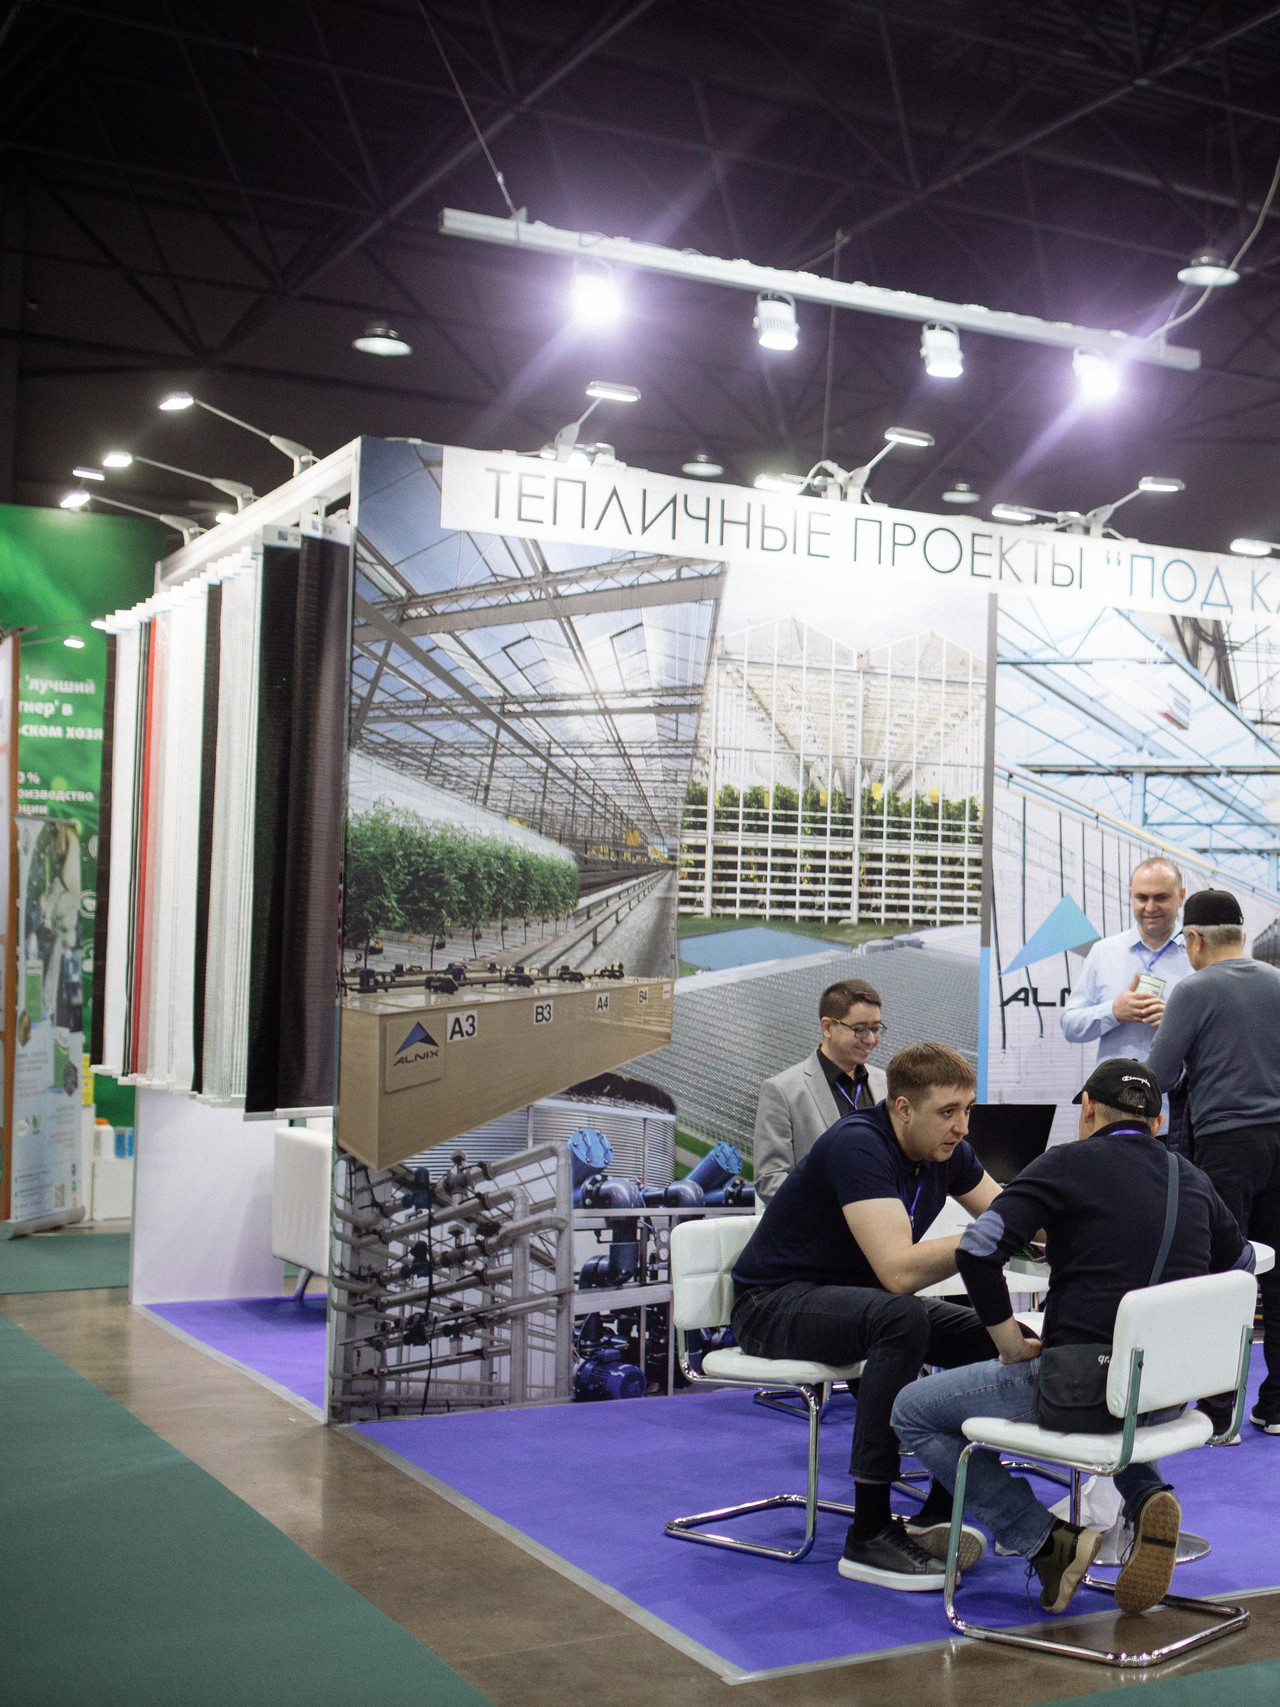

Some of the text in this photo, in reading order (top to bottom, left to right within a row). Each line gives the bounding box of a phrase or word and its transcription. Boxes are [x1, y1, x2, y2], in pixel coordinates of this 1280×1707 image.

[485, 467, 831, 559] ТЕПЛИЧНЫЕ
[853, 517, 1084, 591] ПРОЕКТЫ
[18, 723, 104, 741] ском хозя
[534, 1003, 552, 1023] B3
[596, 995, 609, 1012] A4
[449, 1014, 476, 1040] A3
[393, 1049, 440, 1067] ALNIX
